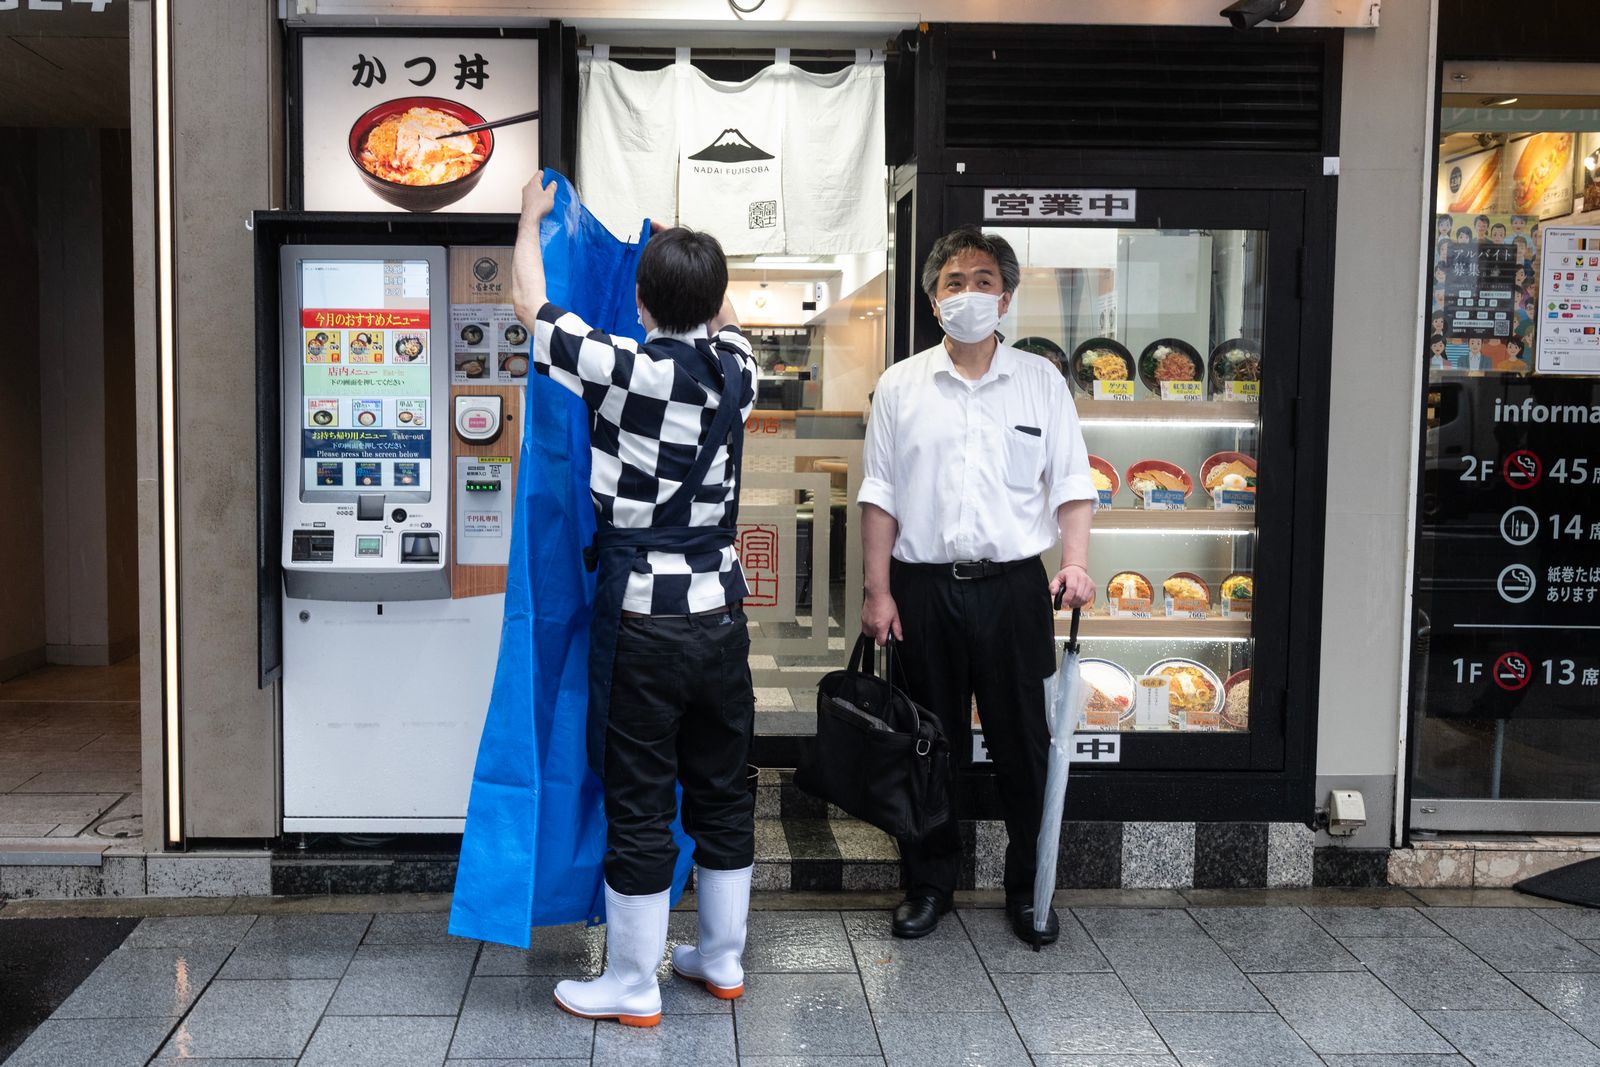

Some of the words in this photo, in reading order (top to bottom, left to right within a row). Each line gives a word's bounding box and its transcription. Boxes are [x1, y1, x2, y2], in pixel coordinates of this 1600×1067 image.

[352, 53, 490, 90] かつ丼
[694, 166, 723, 174] NADAI
[726, 166, 770, 175] FUJISOBA
[991, 193, 1129, 216] 営業中
[1454, 249, 1511, 261] アルバイト
[1453, 262, 1480, 277] 募集
[315, 312, 420, 327] 今月のおすすめメニュー
[328, 367, 378, 376] 店内メニュー
[1494, 398, 1600, 424] informa
[312, 431, 388, 440] お持ち帰り用メニュー
[1460, 455, 1494, 481] 2F
[1547, 586, 1598, 602] あります
[1453, 658, 1483, 683] 1F
